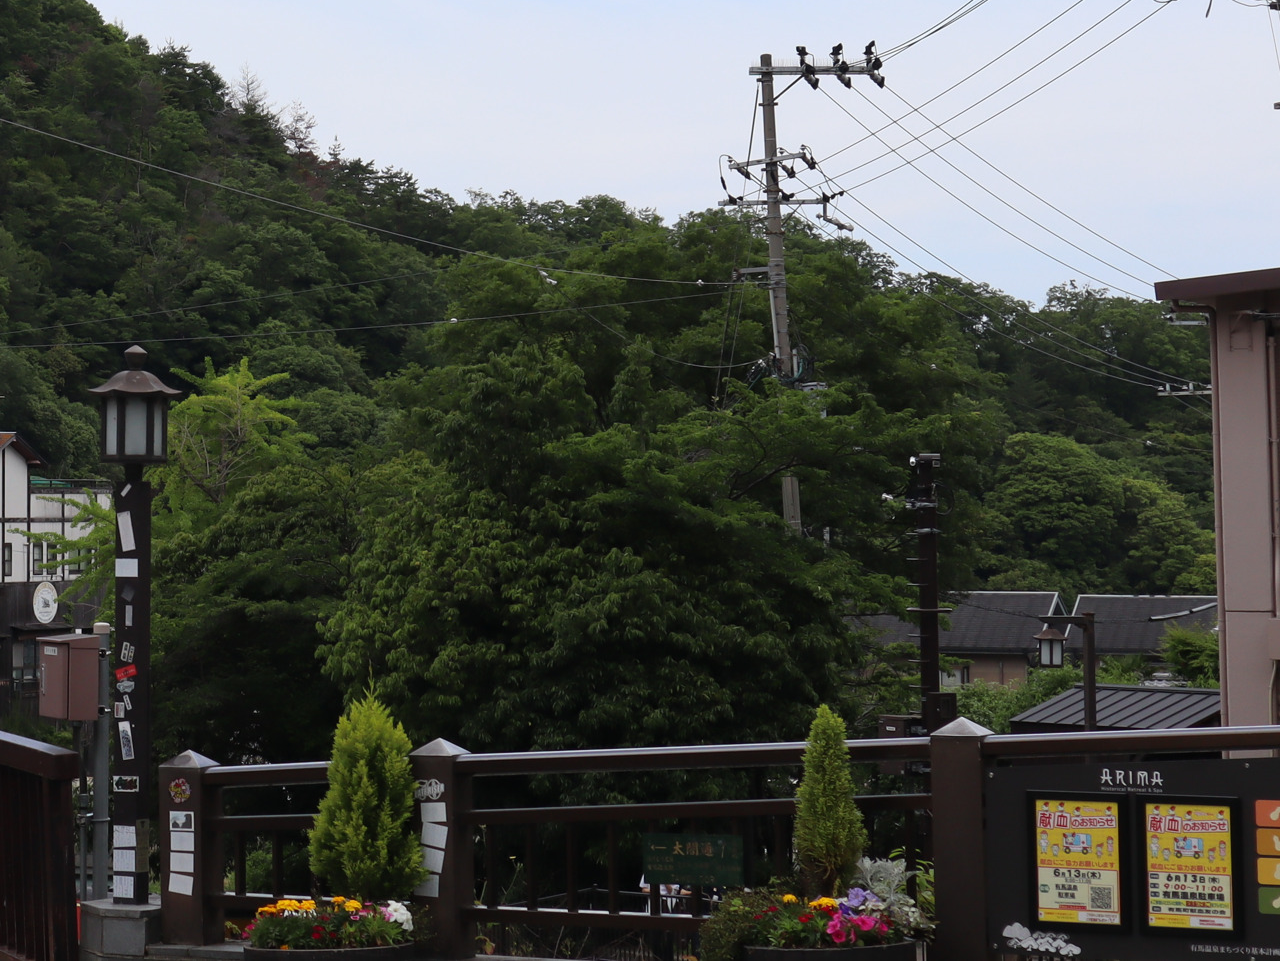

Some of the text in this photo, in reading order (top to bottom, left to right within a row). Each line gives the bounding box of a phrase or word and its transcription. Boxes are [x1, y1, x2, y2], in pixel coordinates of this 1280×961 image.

[1100, 768, 1164, 787] ARIMA
[1040, 812, 1115, 828] 献血のお知らせ
[1150, 817, 1227, 832] 献血のお知らせ
[1163, 891, 1225, 901] 有馬温泉駐車場
